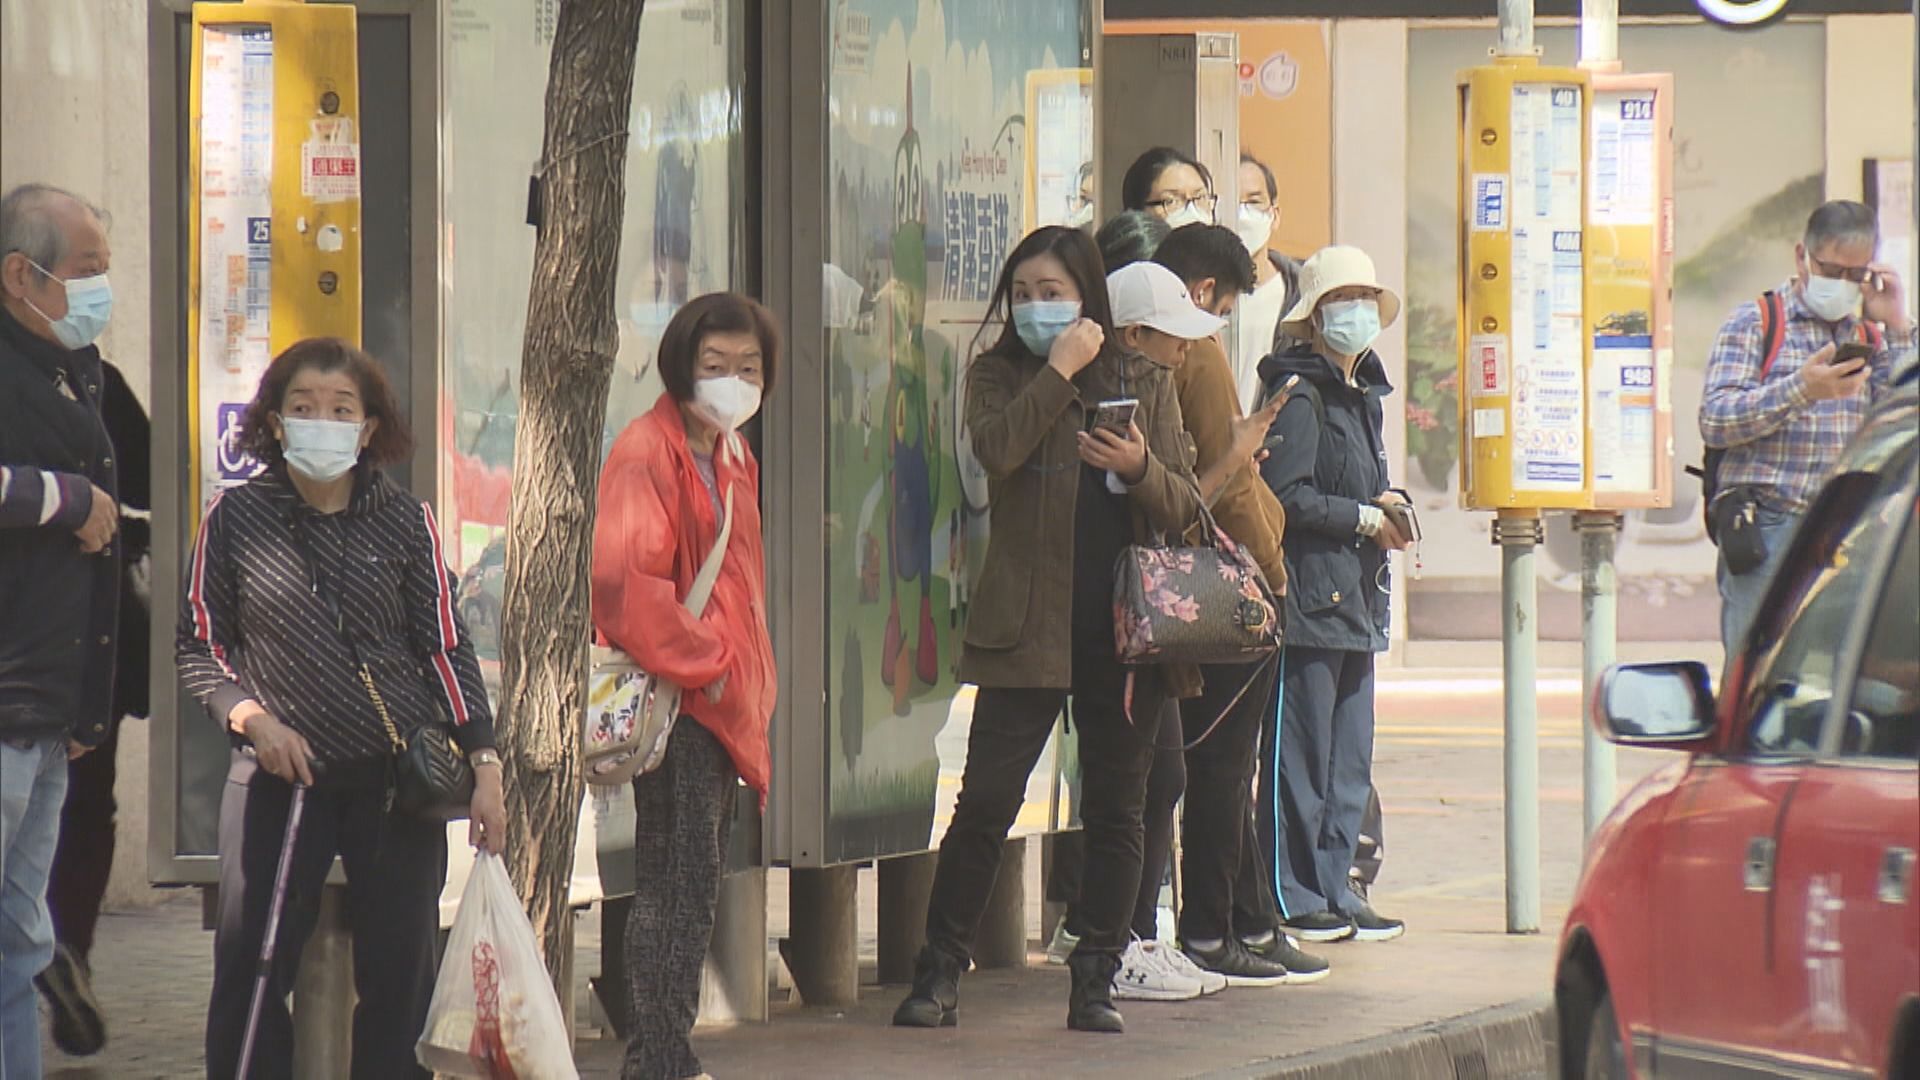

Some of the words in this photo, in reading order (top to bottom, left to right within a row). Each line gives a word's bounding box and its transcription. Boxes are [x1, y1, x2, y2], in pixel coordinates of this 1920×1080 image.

[1554, 88, 1575, 106] 40
[1624, 101, 1651, 119] 914
[253, 221, 269, 241] 25
